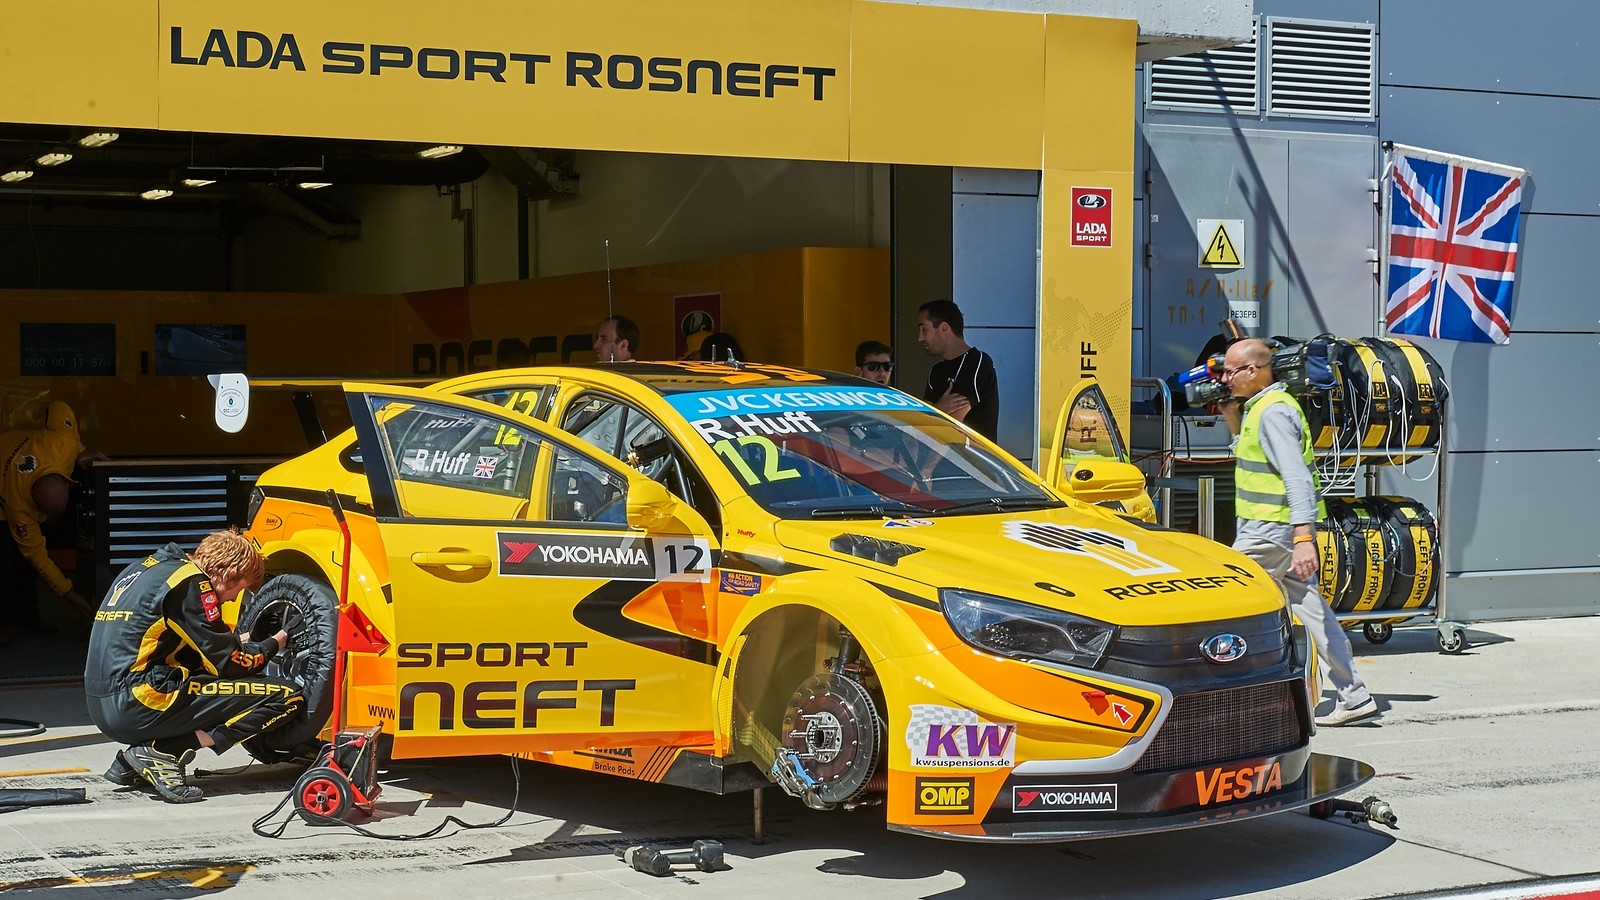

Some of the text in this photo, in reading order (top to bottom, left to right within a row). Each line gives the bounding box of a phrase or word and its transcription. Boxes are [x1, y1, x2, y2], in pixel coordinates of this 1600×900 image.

[171, 26, 836, 101] LADA SPORT ROSNEFT
[1076, 222, 1107, 234] LADA
[1230, 310, 1257, 318] РЕЗЕРВ
[1080, 341, 1097, 379] FF
[690, 411, 822, 444] R.Huff
[413, 449, 471, 475] R.Huff
[713, 435, 801, 486] 12
[537, 545, 705, 574] YOKOHAMA 12
[1412, 540, 1429, 601] LEFT FRONT
[1363, 542, 1381, 605] RIGHT FRONT
[1103, 576, 1248, 600] ROSNEFT
[1322, 579, 1332, 600] REA
[231, 649, 265, 669] ESTA
[397, 641, 588, 668] SPORT
[187, 681, 294, 698] ROSNEFT
[925, 724, 1016, 758] KW
[594, 761, 635, 776] Brake Pads
[915, 757, 1010, 768] kwsuspensions.de
[920, 787, 970, 805] OMP
[1195, 762, 1282, 806] VESTA
[1040, 792, 1112, 804] YOKOHAMA
